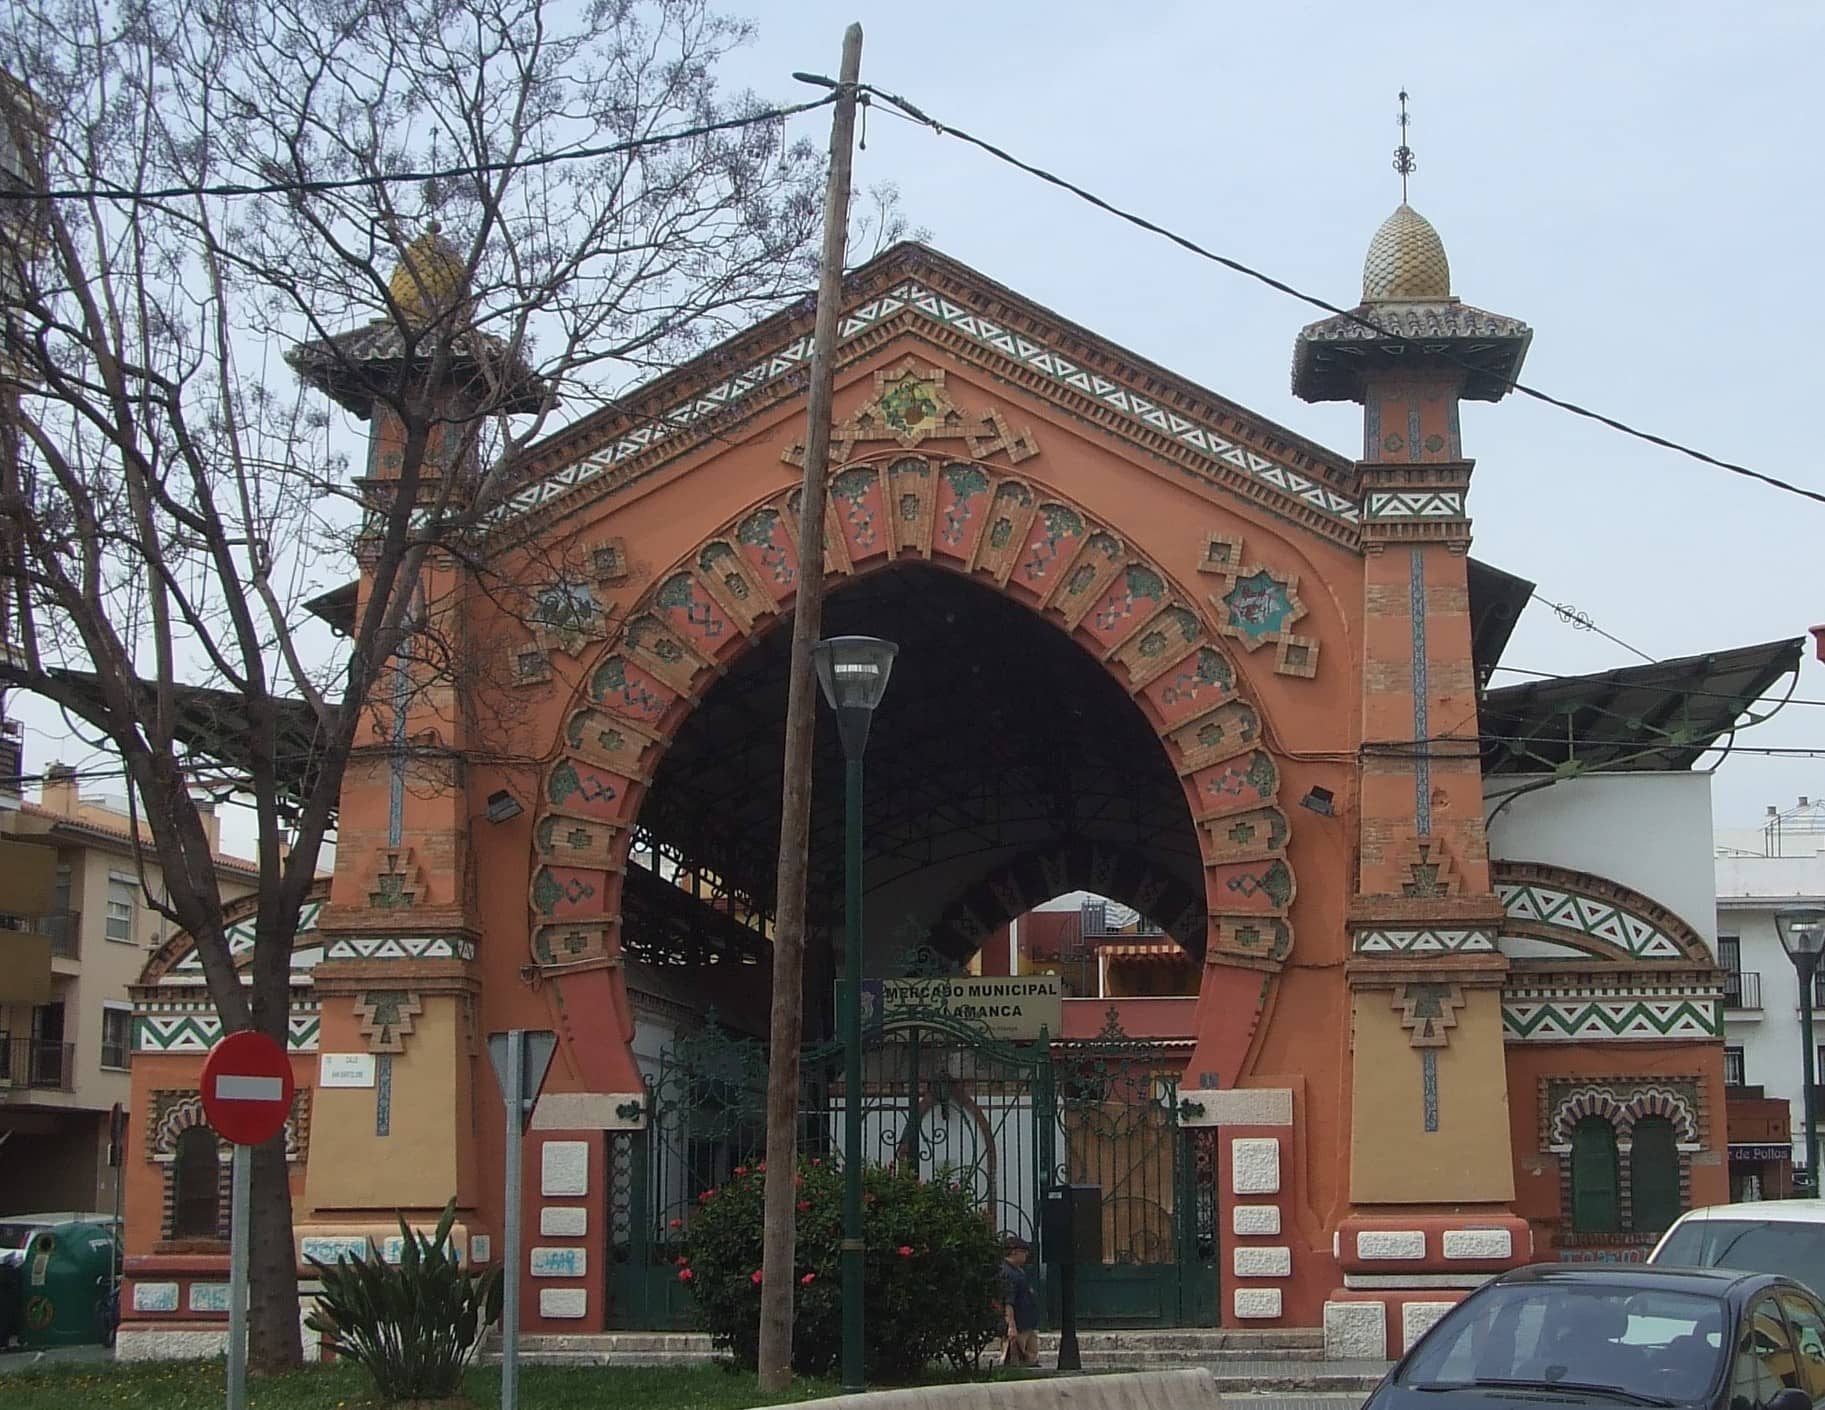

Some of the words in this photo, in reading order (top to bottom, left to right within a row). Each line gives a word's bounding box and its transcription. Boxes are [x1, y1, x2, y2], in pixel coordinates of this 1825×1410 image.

[886, 985, 964, 999] MERCADO
[968, 984, 1057, 997] MUNICIPAL
[1735, 1148, 1750, 1160] de
